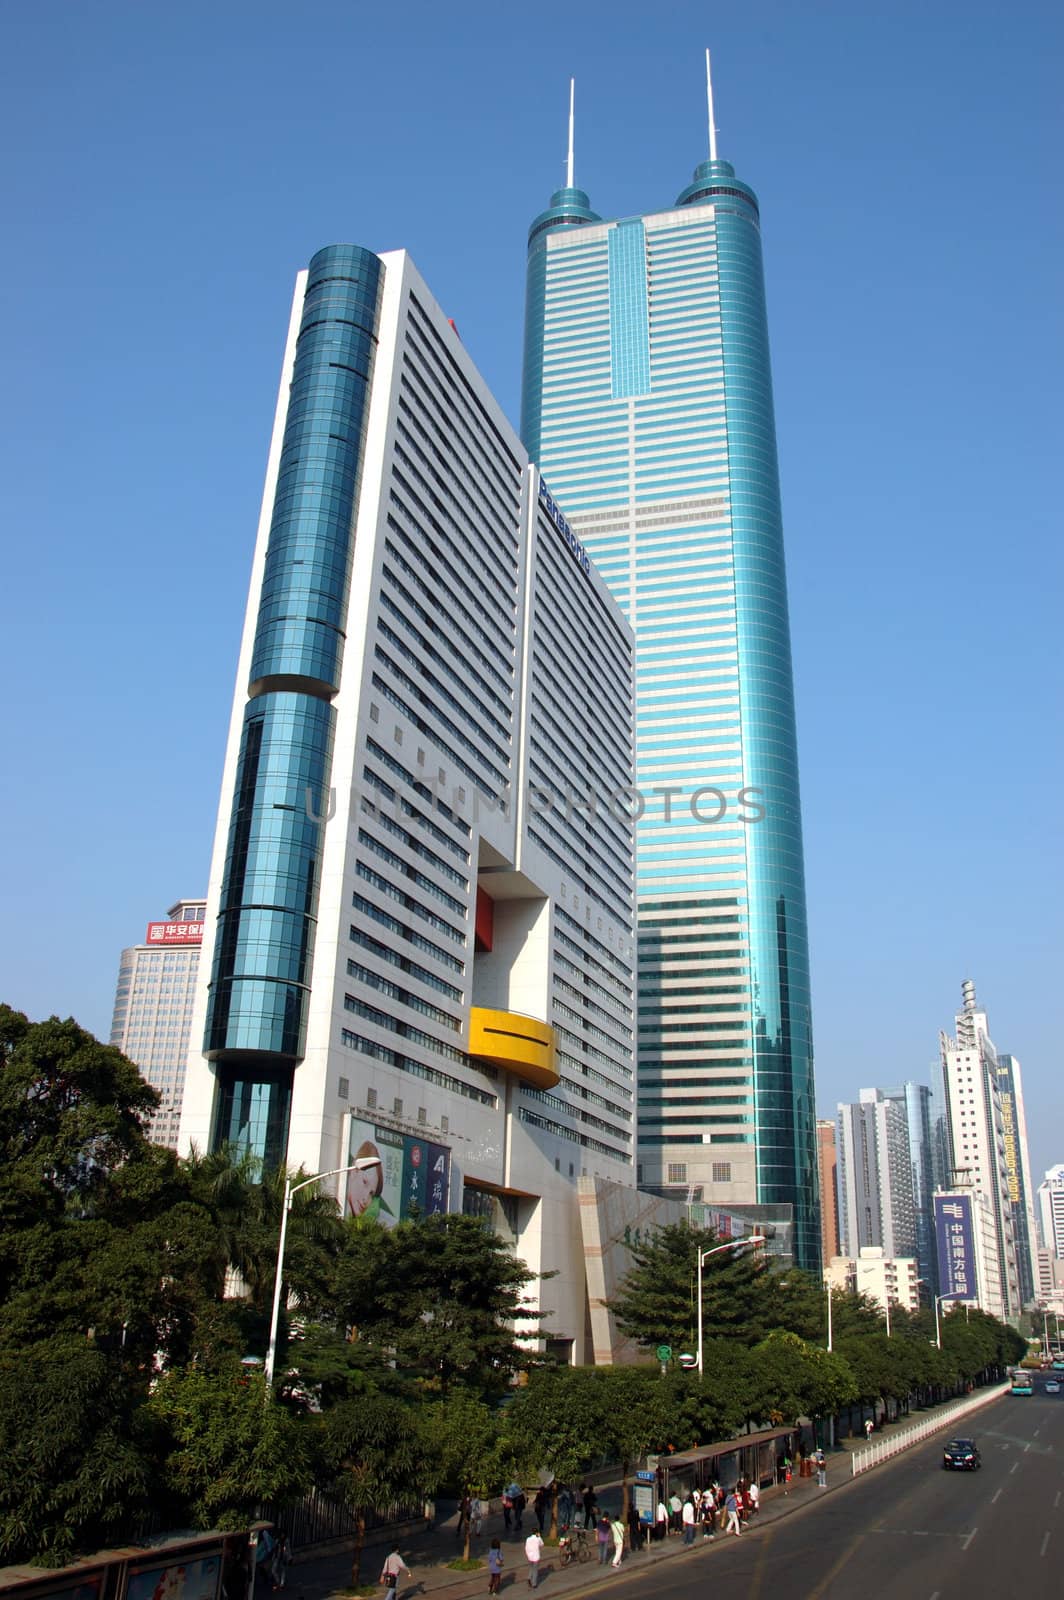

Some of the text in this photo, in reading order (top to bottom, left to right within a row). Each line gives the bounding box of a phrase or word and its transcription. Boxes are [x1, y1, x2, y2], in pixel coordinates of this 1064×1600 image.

[539, 474, 590, 575] Panasonic
[951, 1223, 968, 1295] 中国南方电网
